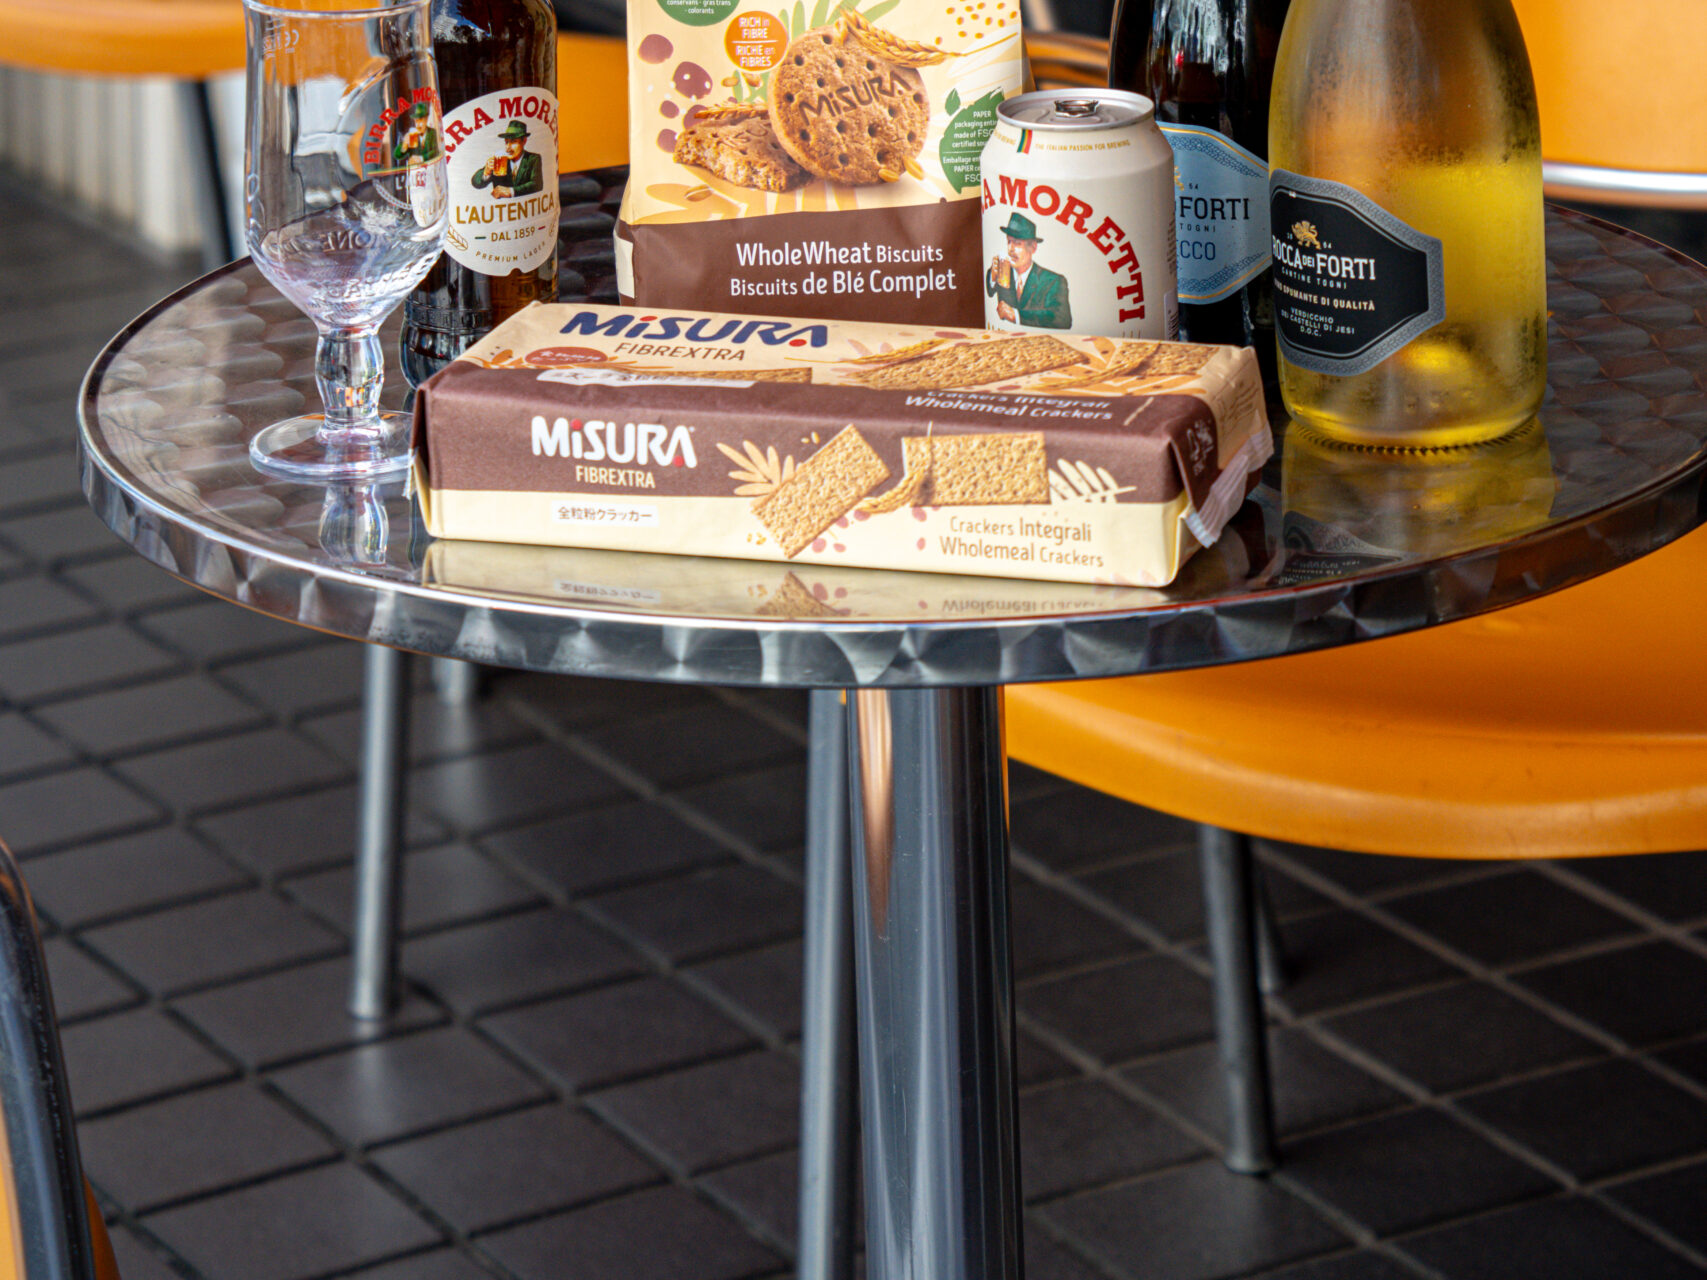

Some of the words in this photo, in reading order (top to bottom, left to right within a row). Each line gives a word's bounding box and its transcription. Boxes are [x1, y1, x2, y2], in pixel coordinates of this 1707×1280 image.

[738, 16, 761, 28] RICH
[761, 17, 770, 27] in
[742, 27, 769, 39] FIBRE
[736, 45, 764, 56] RICHE
[740, 56, 773, 67] FIBRES
[973, 110, 992, 118] PAPER
[364, 96, 412, 164] BIRRA
[954, 120, 983, 130] packaging
[970, 130, 977, 138] of
[951, 140, 976, 148] certified
[1069, 143, 1093, 151] PASSION
[1094, 142, 1106, 150] FOR
[1106, 139, 1131, 150] BREWING
[943, 156, 971, 165] Emballage
[953, 164, 974, 173] PAPIER
[456, 191, 555, 225] L'AUTENTICA
[491, 232, 512, 242] DAL
[514, 226, 536, 240] 1859
[475, 250, 519, 262] PREMIUM
[523, 240, 546, 260] LAGER
[876, 245, 944, 263] Biscuits
[998, 174, 1146, 323] MORETTI
[1272, 234, 1303, 270] ROCCA
[1302, 254, 1315, 268] DEI
[1316, 253, 1376, 280] FORTI
[730, 276, 798, 297] Biscuits
[802, 272, 828, 294] de
[833, 269, 865, 294] Blé
[869, 268, 957, 298] Complet
[1281, 266, 1312, 283] CANTINE
[1316, 277, 1347, 289] TOGNI
[1283, 284, 1318, 304] SPUMANTE
[1320, 296, 1330, 307] DI
[1332, 298, 1376, 311] QUALITÀ
[1290, 306, 1334, 324] VERDICCHIO
[1289, 314, 1321, 329] CASTELLI
[1323, 323, 1333, 332] DI
[1335, 326, 1355, 335] JESI
[1300, 325, 1322, 337] D.O.C.
[614, 342, 746, 362] FIBREXTRA
[904, 395, 1029, 417] Wholemeal
[1029, 406, 1114, 421] Crackers
[575, 465, 657, 489] FIBREXTRA
[557, 506, 653, 522] 全粒粉クラッカー
[950, 515, 1015, 537] Crackers
[1018, 516, 1093, 544] Integrali
[939, 535, 1036, 563] Wholemeal
[1039, 544, 1105, 568] Crackers
